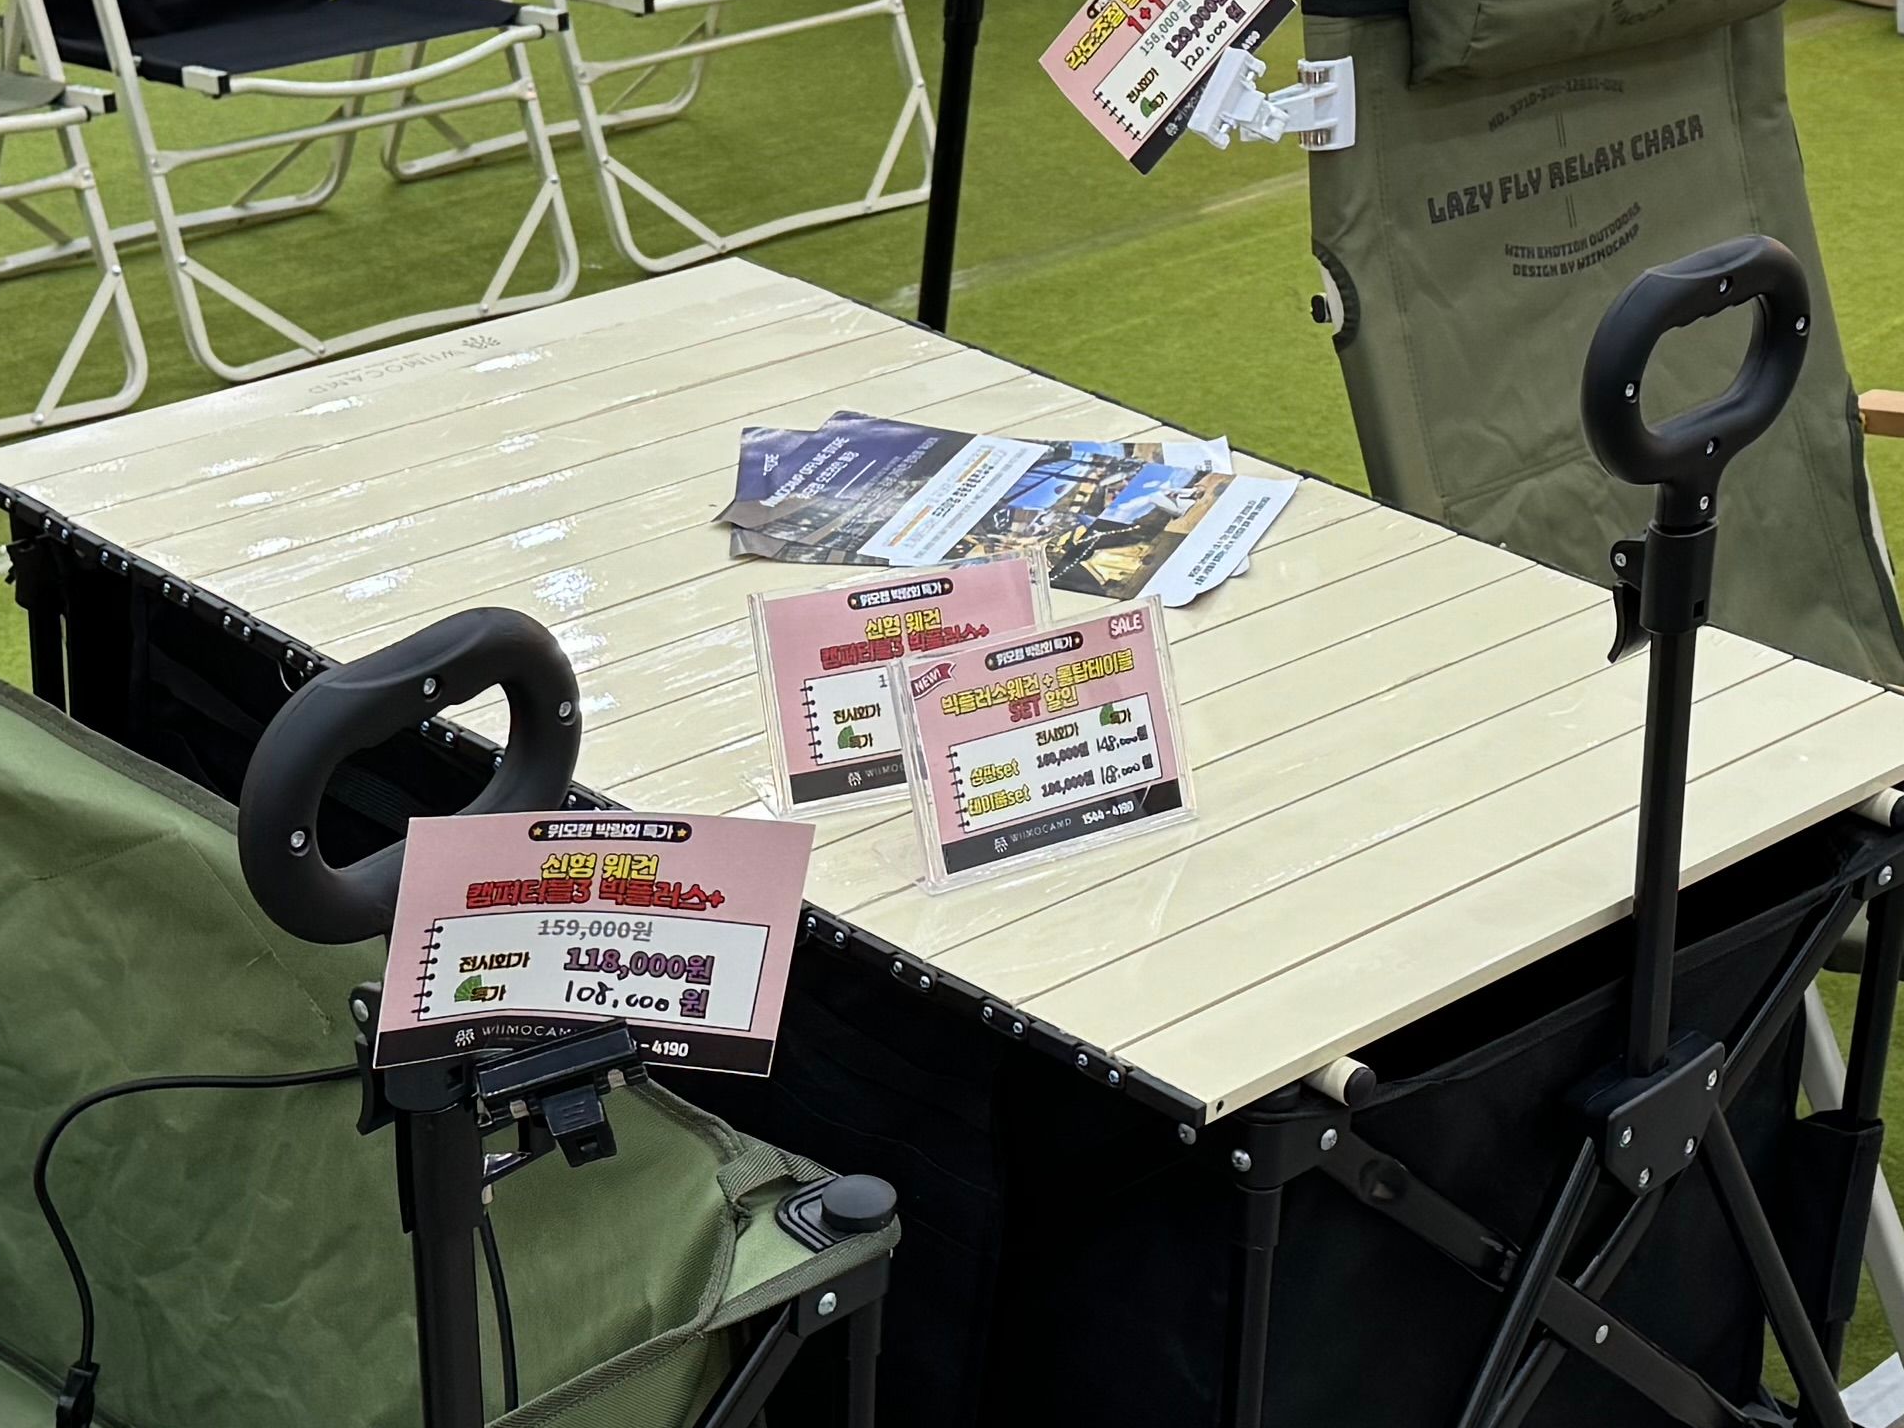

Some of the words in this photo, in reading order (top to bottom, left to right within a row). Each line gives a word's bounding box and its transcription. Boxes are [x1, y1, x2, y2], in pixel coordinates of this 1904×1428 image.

[1064, 0, 1129, 71] 각도조절
[1427, 180, 1493, 225] LAZY
[1499, 167, 1543, 205] FLY
[1547, 140, 1626, 191] RELAX
[1631, 114, 1705, 162] CHAIR
[1505, 243, 1536, 260] WITH
[1537, 236, 1588, 259] EMOTION
[1588, 202, 1641, 246] OUTDOORS
[1512, 263, 1558, 278] DESIGN
[1560, 261, 1576, 275] BY
[1577, 224, 1640, 270] WIIMOCAMP
[864, 613, 901, 640] 신형
[903, 607, 942, 633] 웨건
[1109, 614, 1144, 639] SALE
[914, 669, 942, 693] NEW!
[940, 675, 1041, 716] 빅플러스웨건
[1042, 673, 1054, 689] +
[1055, 649, 1135, 688] 롤탑테이블
[833, 702, 881, 724] 전시회가
[1008, 696, 1042, 723] SET
[1044, 685, 1079, 713] 할인
[1036, 722, 1079, 747] 전시회가
[547, 823, 592, 840] 위모캠
[595, 823, 640, 840] 박람회
[643, 824, 676, 840] 특가
[540, 853, 596, 881] 신형
[600, 853, 660, 881] 웨건
[465, 879, 591, 910] 캠퍼터블3
[598, 879, 726, 911] 빅플러스+
[536, 918, 654, 943] 159,000원
[458, 952, 531, 973] 전시회가
[562, 946, 716, 986] 118,000원
[679, 988, 709, 1019] 원
[481, 1021, 577, 1038] WIIMOCAM
